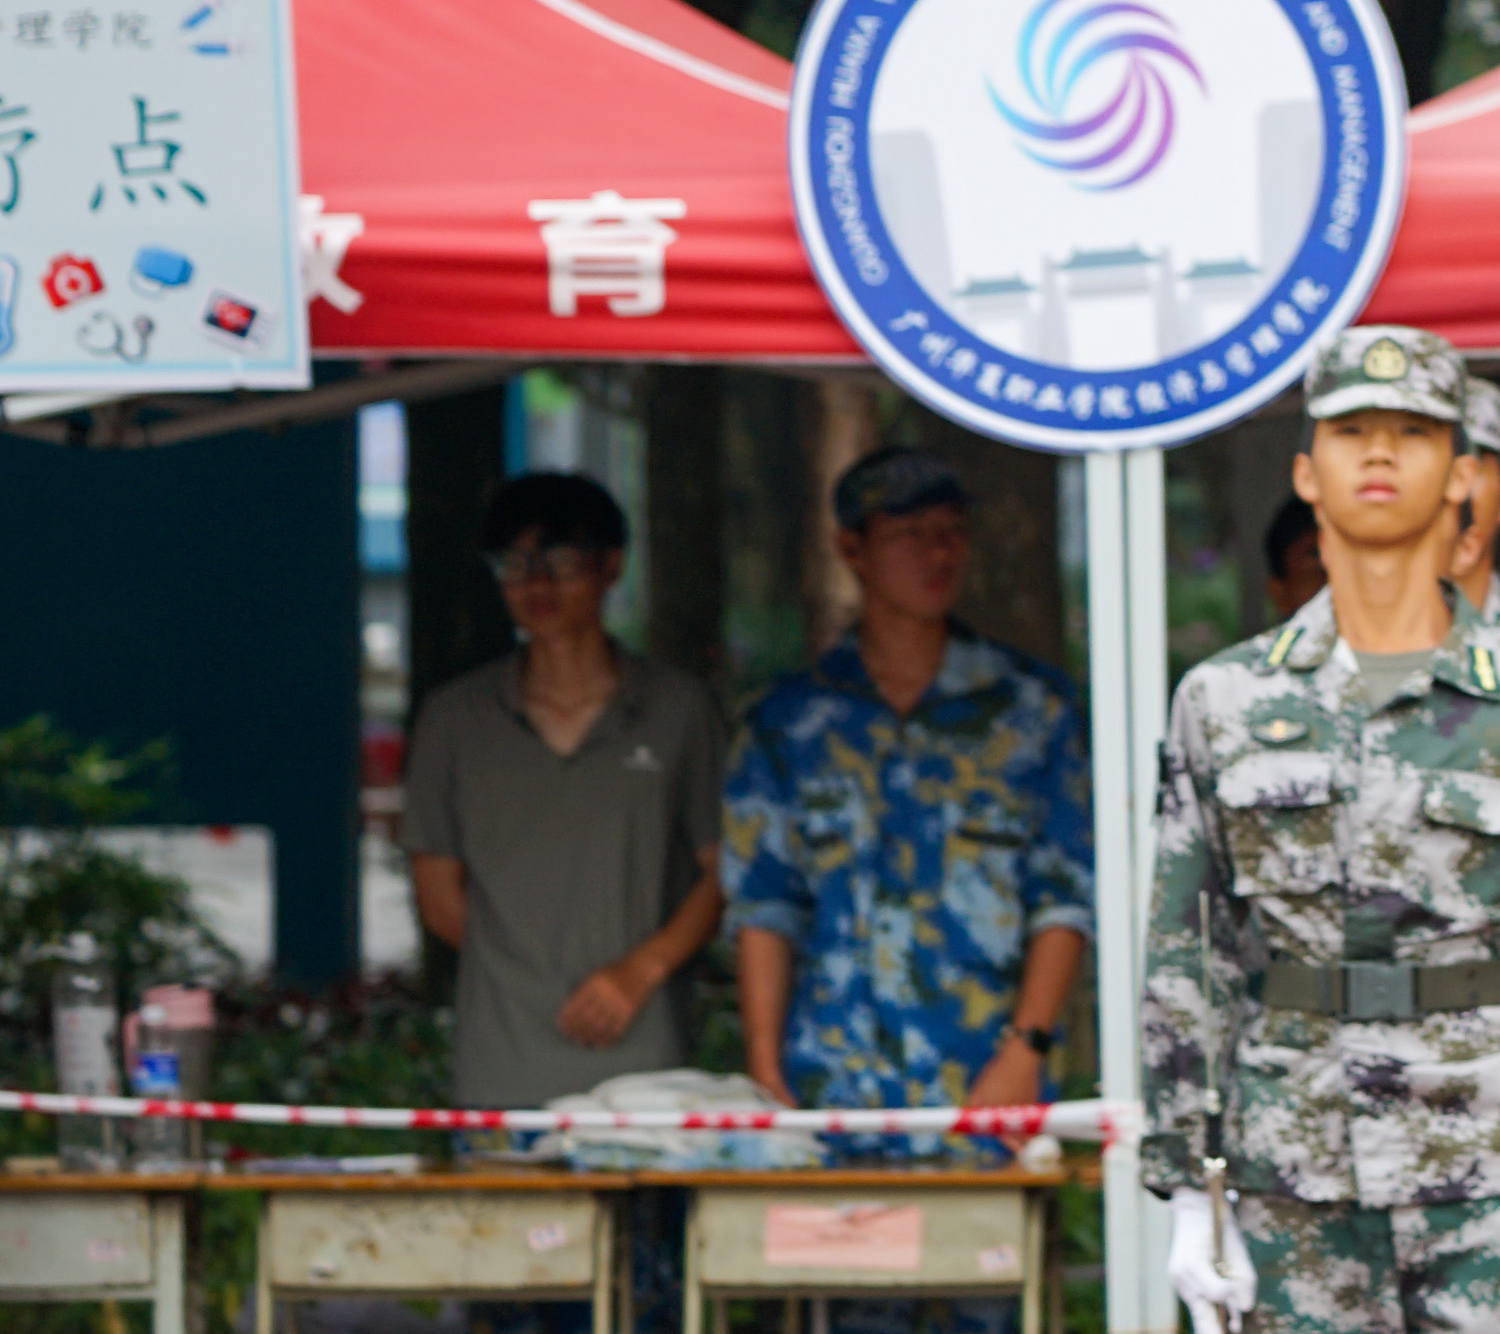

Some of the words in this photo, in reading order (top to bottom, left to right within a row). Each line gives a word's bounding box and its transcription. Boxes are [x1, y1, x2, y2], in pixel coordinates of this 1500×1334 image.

[0, 8, 152, 48] 理学院
[1301, 0, 1349, 57] AND
[824, 115, 890, 287] GUANGZHOU
[1322, 64, 1370, 254] MANAGEMENT
